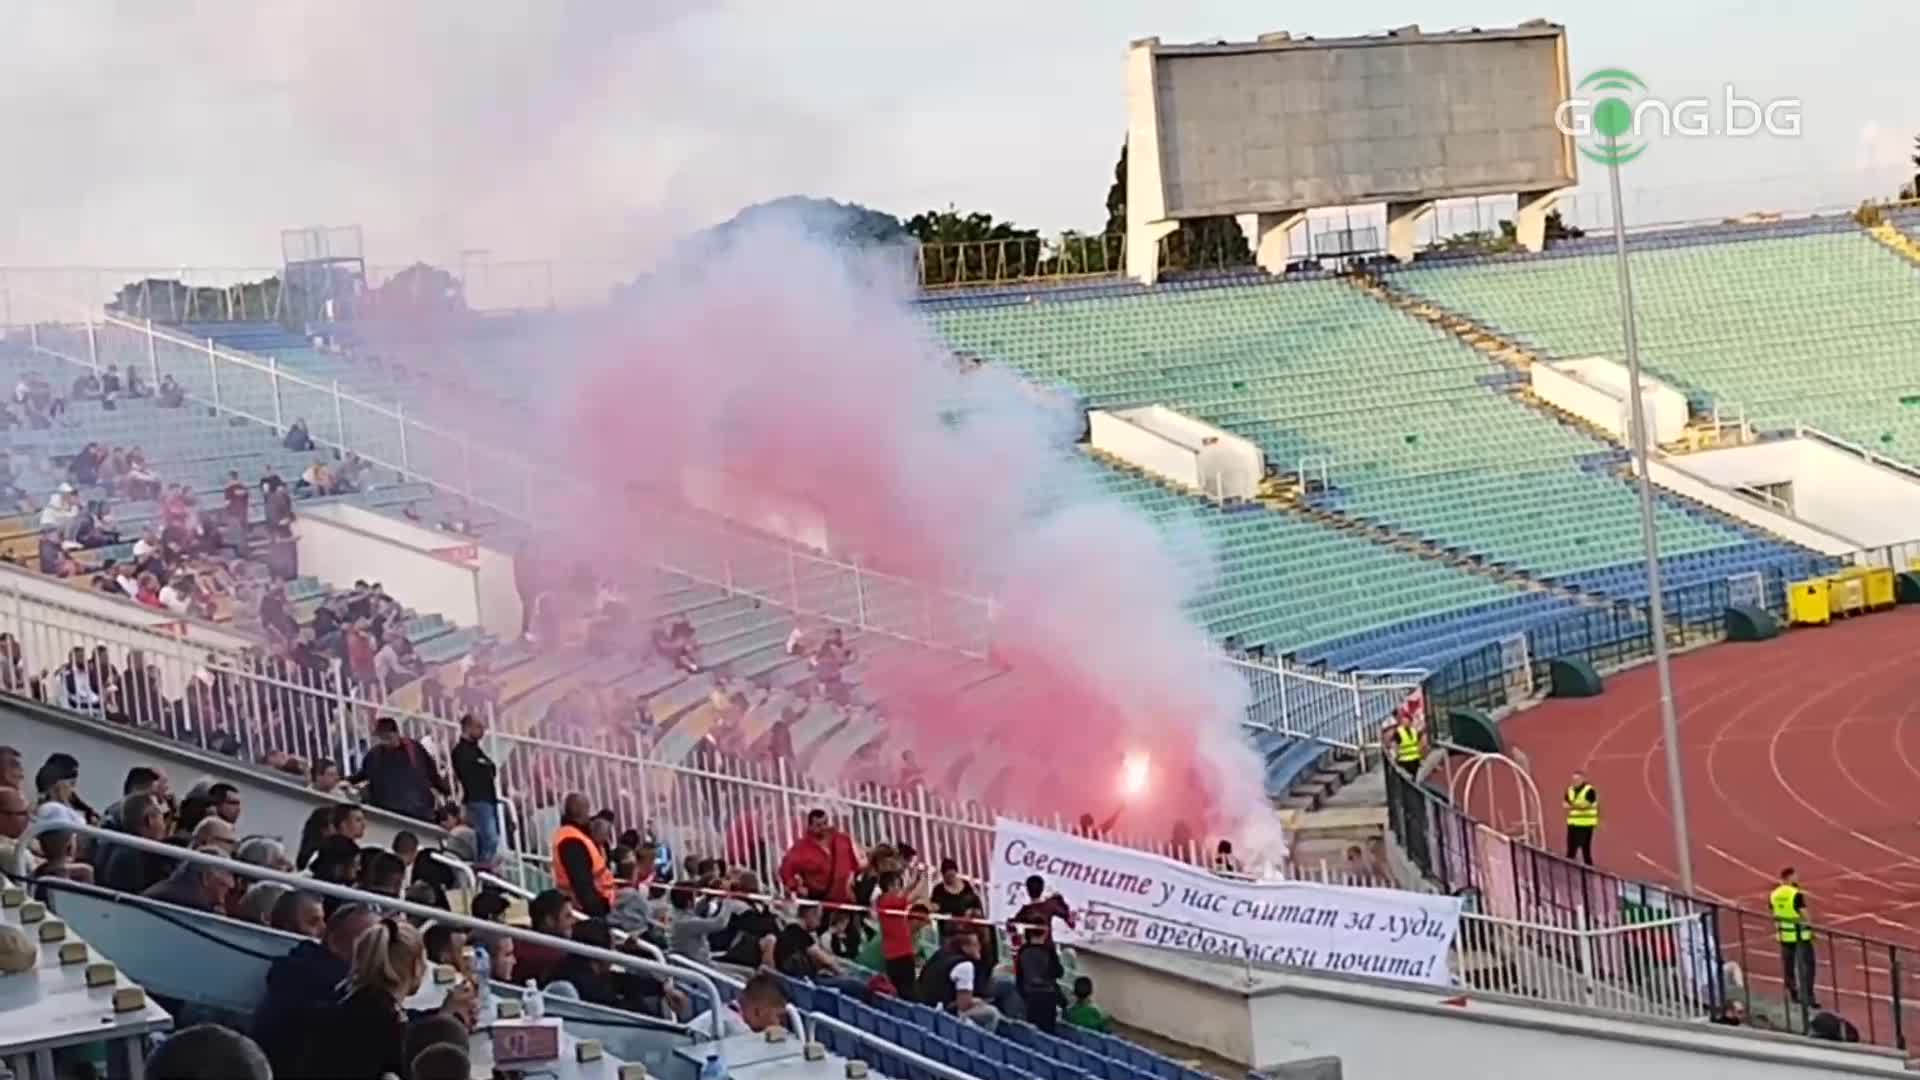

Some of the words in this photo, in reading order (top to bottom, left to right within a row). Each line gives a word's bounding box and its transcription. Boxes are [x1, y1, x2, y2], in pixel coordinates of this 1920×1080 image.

[1005, 839, 1152, 895] Свестните
[1152, 881, 1175, 907] у
[1181, 887, 1227, 912] нас
[1232, 899, 1339, 928] считат
[1344, 911, 1375, 931] за
[1379, 906, 1446, 942] луди,
[1145, 921, 1237, 959] вредом
[1245, 943, 1317, 967] всеки
[1325, 950, 1437, 978] почита!
